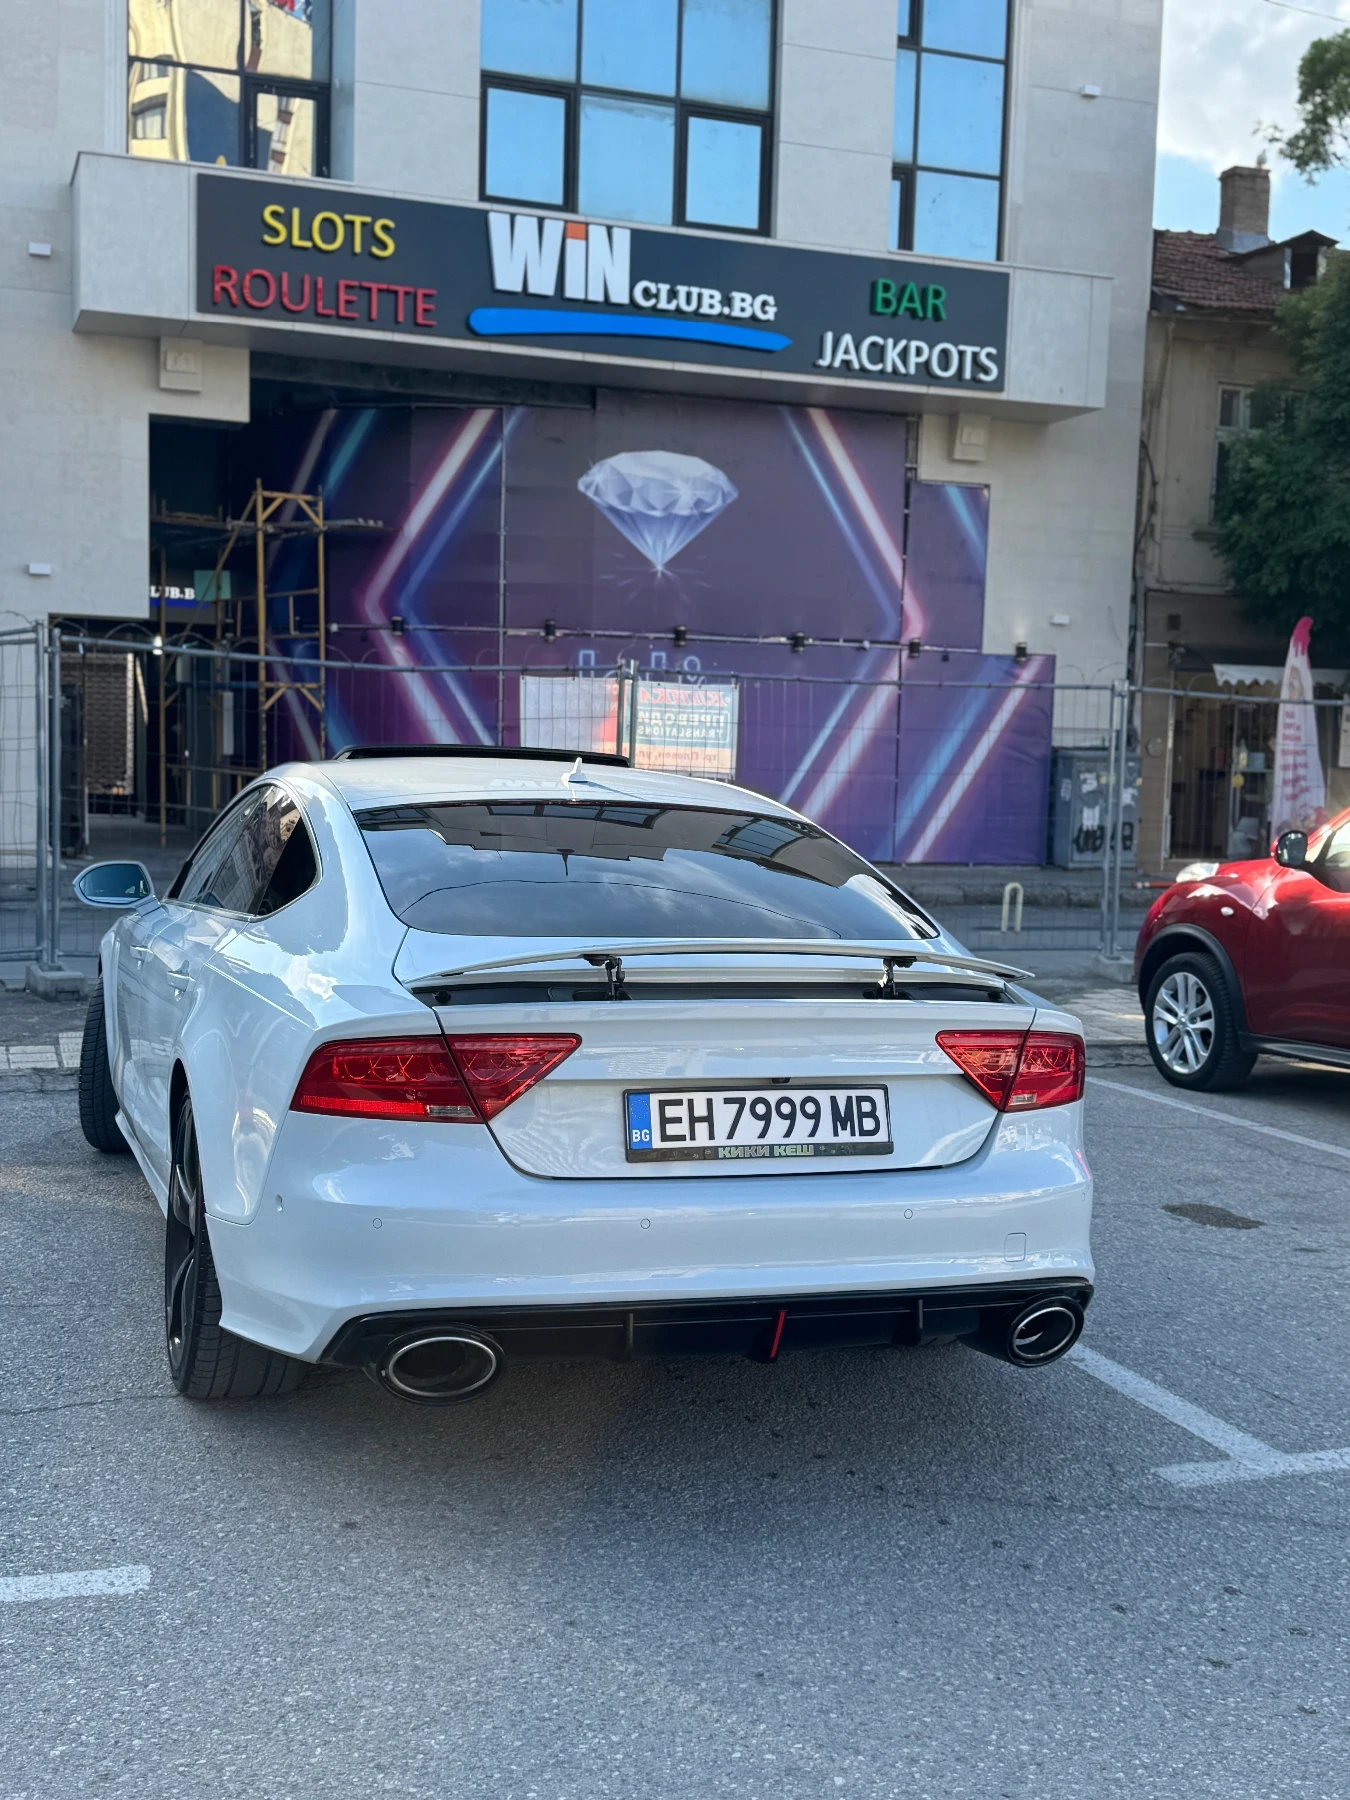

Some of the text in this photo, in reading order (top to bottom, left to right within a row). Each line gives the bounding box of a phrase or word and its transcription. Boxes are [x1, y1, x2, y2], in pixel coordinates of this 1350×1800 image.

[262, 204, 396, 258] SLOTS
[213, 264, 437, 327] ROULETTE
[633, 280, 778, 321] CLUB.BG
[875, 277, 947, 320] BAR
[816, 330, 999, 382] JACKPOTS
[150, 585, 196, 600] LUB.B
[632, 1129, 650, 1142] BG
[718, 1144, 814, 1159] КИКИ КЕШ
